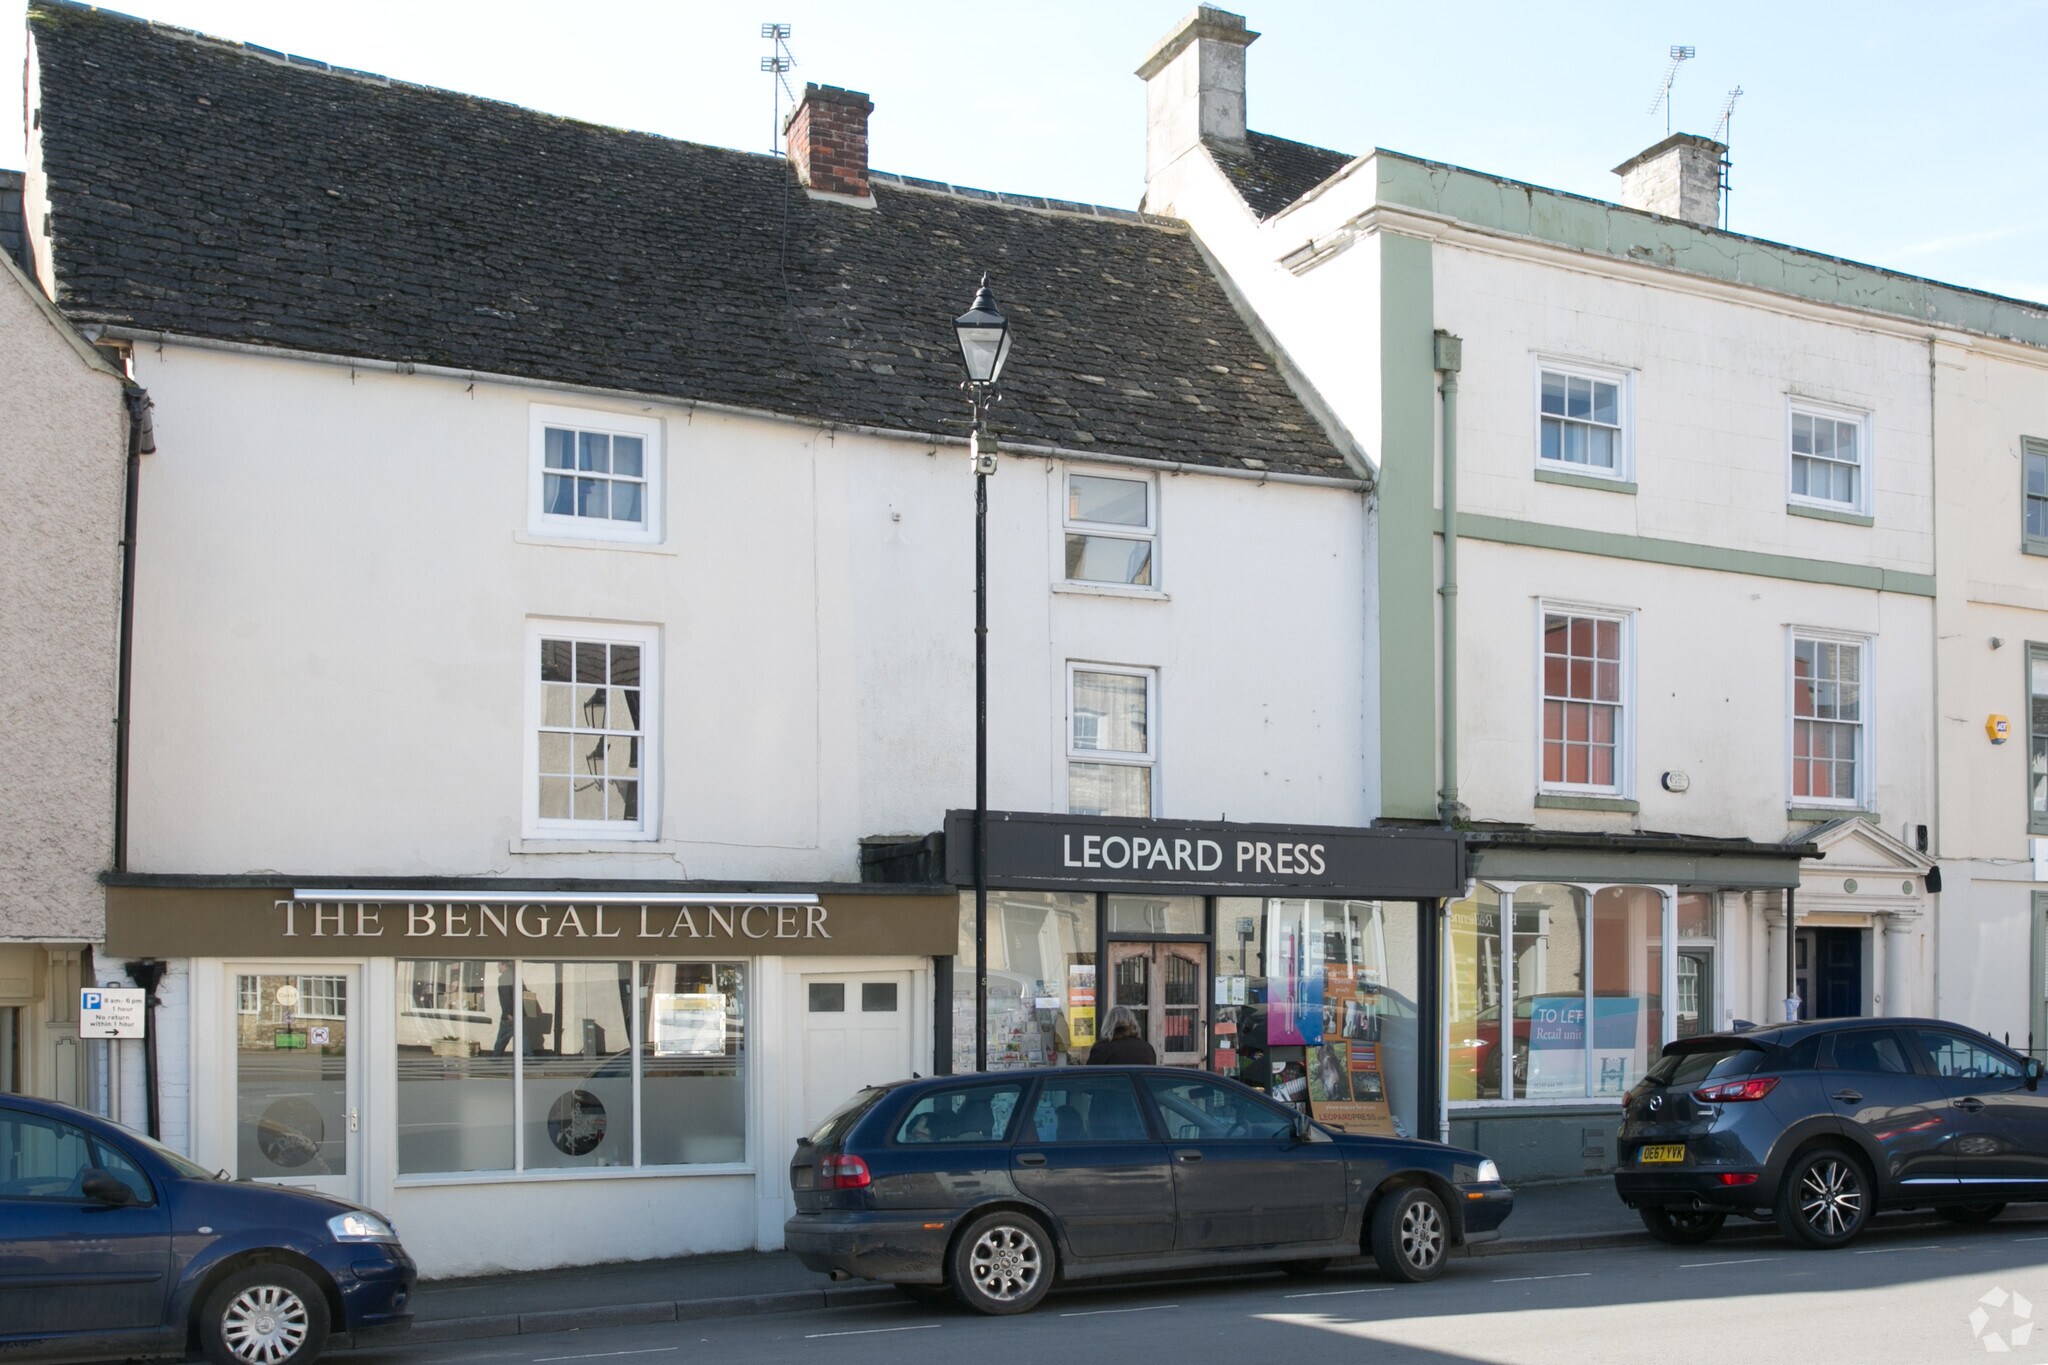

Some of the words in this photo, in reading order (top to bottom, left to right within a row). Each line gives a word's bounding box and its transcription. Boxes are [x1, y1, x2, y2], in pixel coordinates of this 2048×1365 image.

[1064, 835, 1223, 871] LEOPARD
[1237, 841, 1326, 875] PRESS
[275, 900, 384, 937] THE
[404, 903, 621, 938] BENGAL
[637, 904, 832, 939] LANCER
[86, 993, 100, 1009] P
[1539, 1009, 1556, 1023] TO
[1561, 1009, 1584, 1024] LET
[1537, 1028, 1562, 1039] Retail
[1564, 1029, 1582, 1040] unit
[1644, 1147, 1665, 1159] OE67
[1667, 1146, 1683, 1158] YVK
